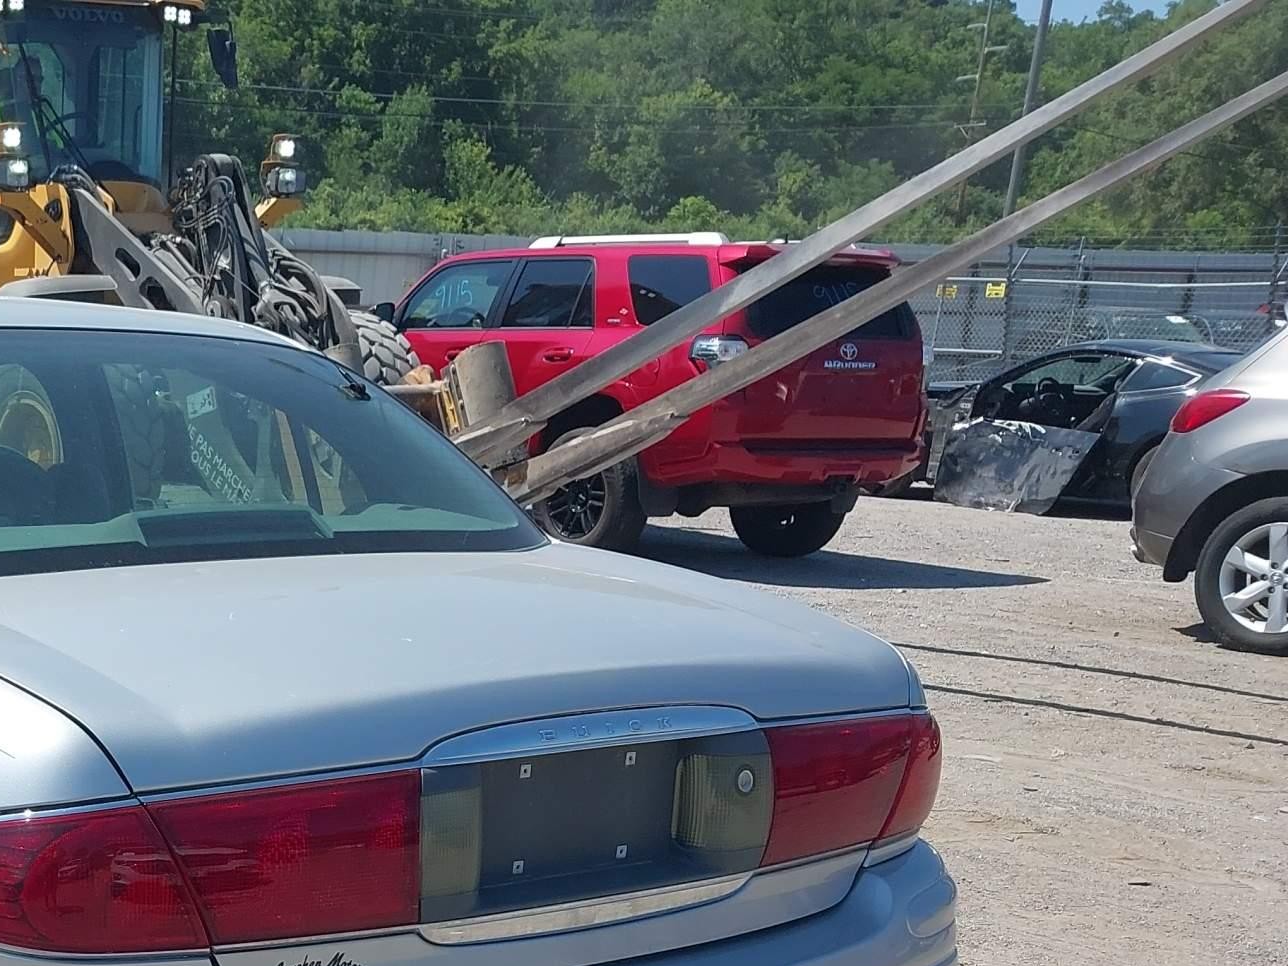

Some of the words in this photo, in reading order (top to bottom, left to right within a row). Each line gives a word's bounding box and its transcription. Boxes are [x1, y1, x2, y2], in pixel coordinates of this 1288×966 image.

[50, 7, 124, 23] VOLVO
[435, 280, 473, 308] 9115
[195, 433, 215, 459] PAS
[190, 445, 212, 476] OUS
[210, 470, 224, 489] LE
[538, 715, 672, 742] BUICK
